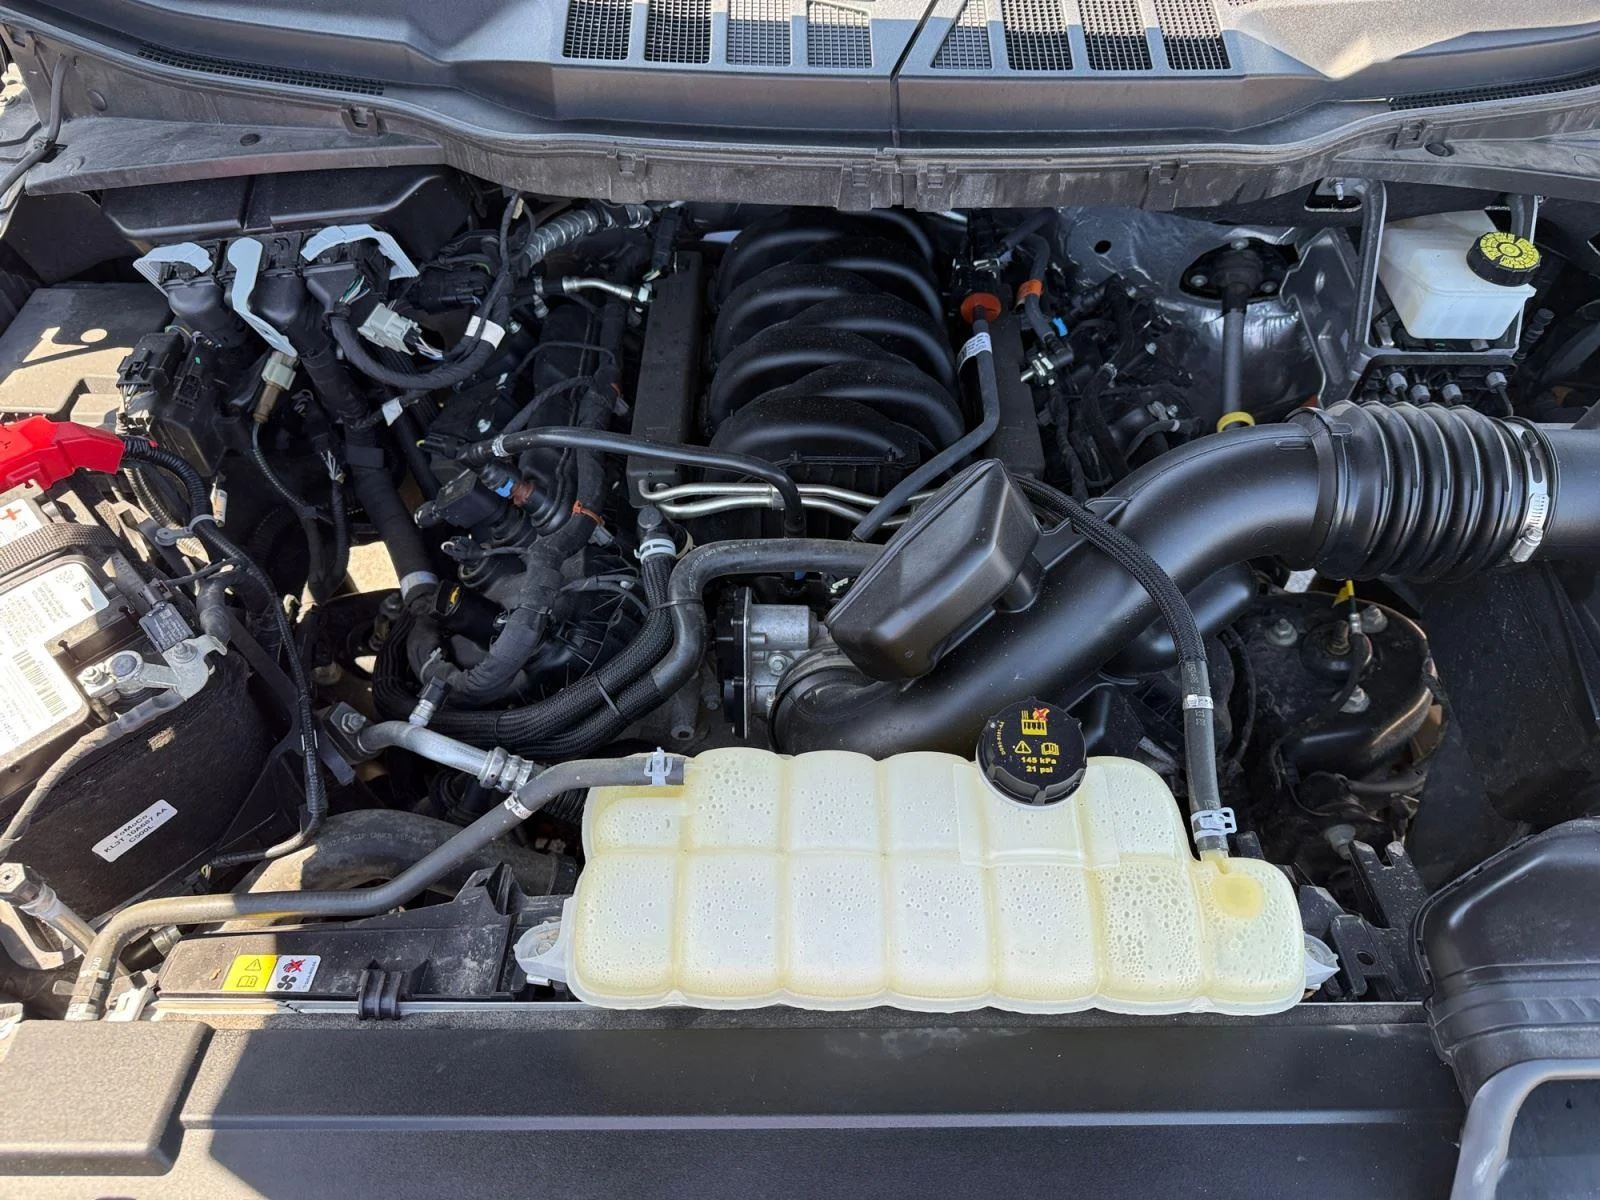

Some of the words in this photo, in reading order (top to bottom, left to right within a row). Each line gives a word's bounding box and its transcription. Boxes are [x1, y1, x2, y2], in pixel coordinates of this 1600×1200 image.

[1021, 756, 1038, 764] 145
[1039, 757, 1057, 765] kPa
[1025, 765, 1037, 773] 21
[1039, 766, 1053, 774] psi
[103, 836, 125, 853] KL3T
[156, 808, 168, 817] AA
[114, 815, 148, 839] FoMoCo
